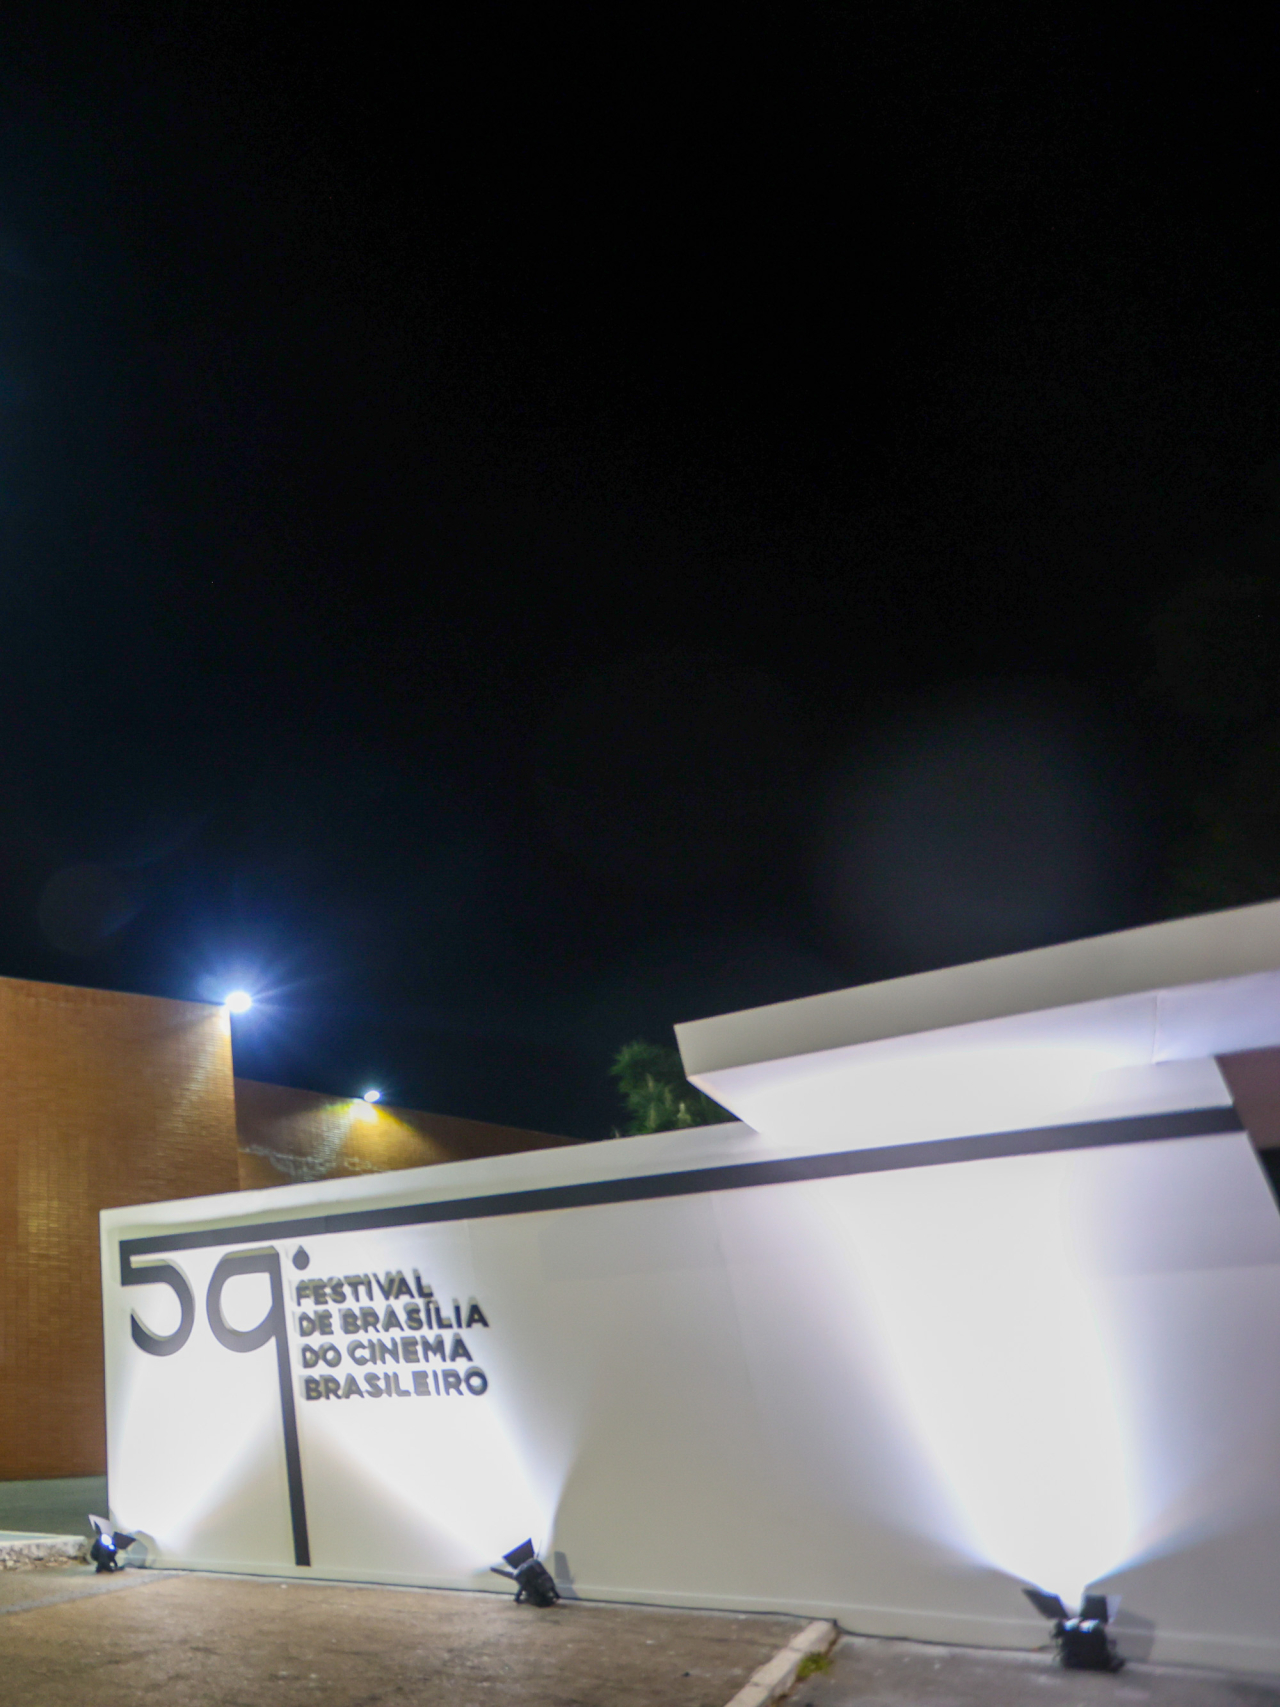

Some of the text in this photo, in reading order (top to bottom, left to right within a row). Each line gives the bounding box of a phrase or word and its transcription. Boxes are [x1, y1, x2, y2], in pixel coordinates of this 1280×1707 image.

[295, 1268, 435, 1307] FESTIVAL
[297, 1296, 490, 1338] DE BRASÍLIA
[300, 1332, 474, 1369] DO CINEMA
[301, 1365, 489, 1402] BRASILEIRO
